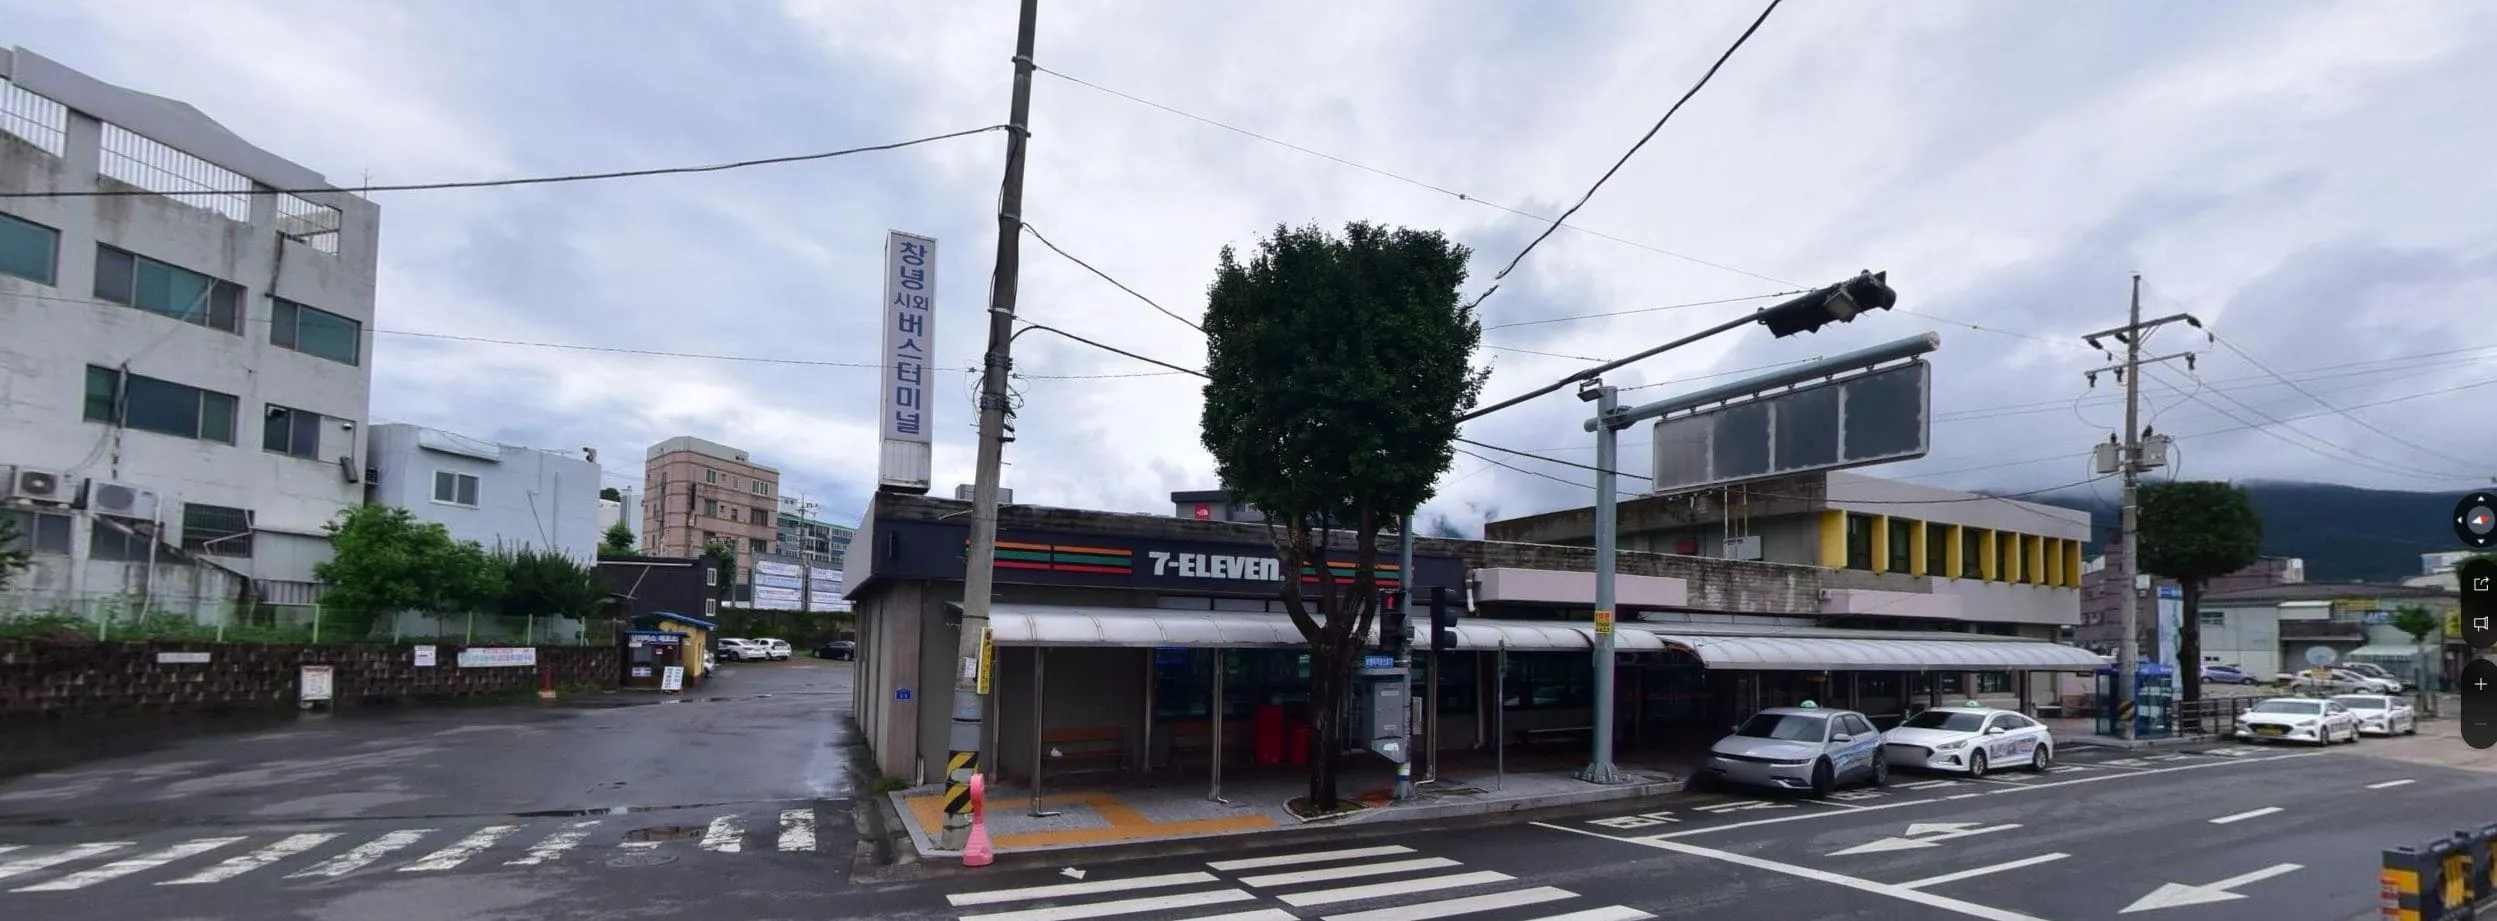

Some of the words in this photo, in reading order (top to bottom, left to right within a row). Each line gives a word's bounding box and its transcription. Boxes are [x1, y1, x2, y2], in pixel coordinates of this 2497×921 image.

[900, 241, 927, 290] 창녕
[893, 292, 929, 311] 시외
[895, 312, 923, 435] 버스터미널
